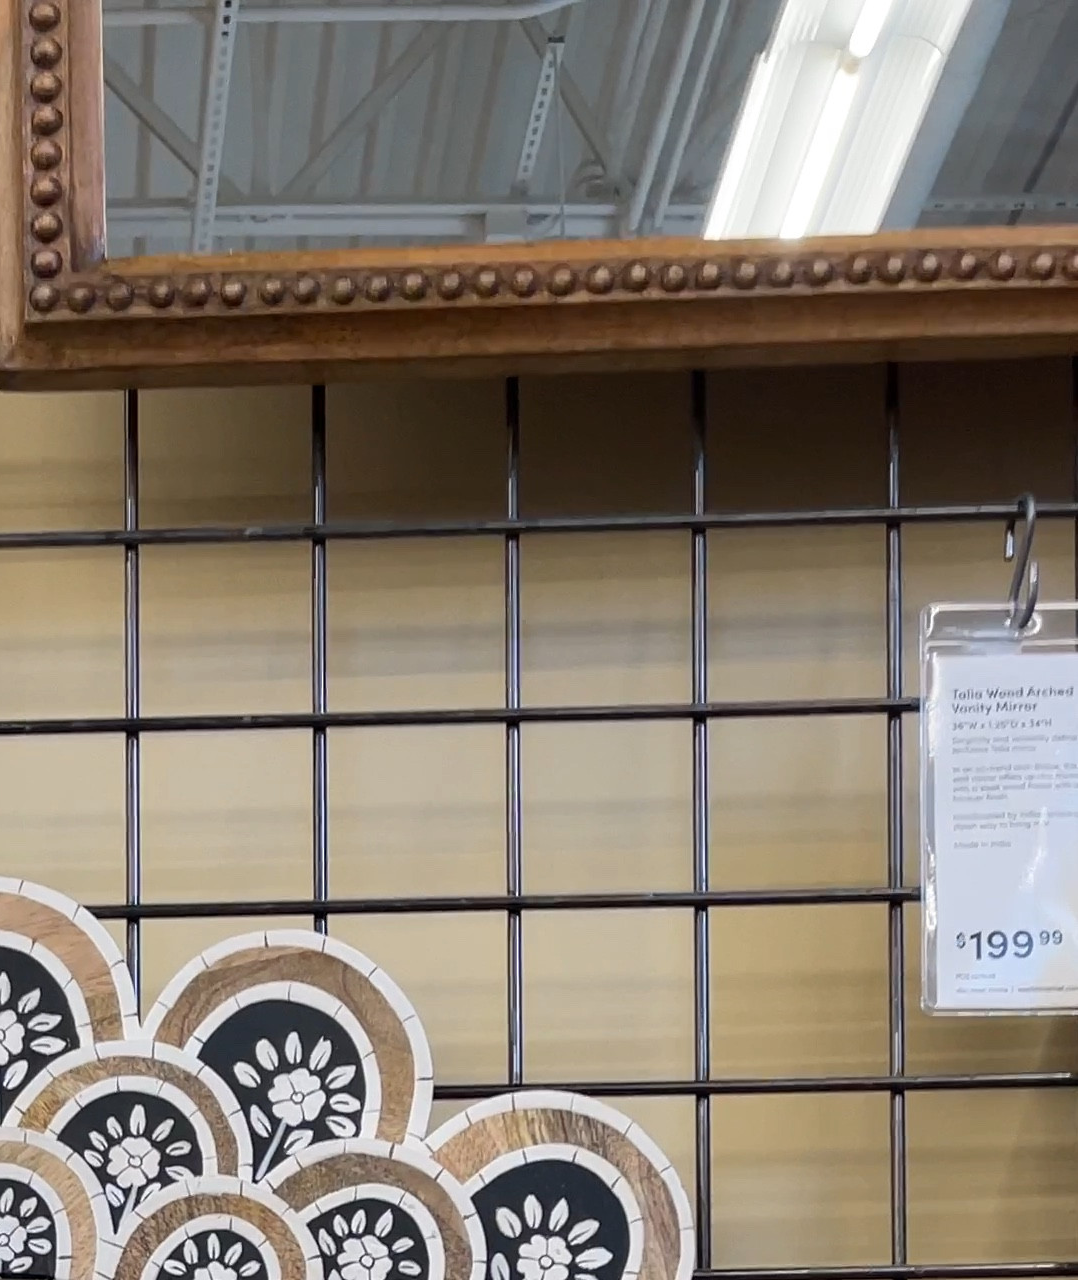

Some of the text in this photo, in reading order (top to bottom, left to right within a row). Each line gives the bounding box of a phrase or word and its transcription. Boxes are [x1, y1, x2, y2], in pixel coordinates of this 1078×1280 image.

[986, 687, 1024, 699] Wood
[1027, 686, 1074, 697] Arched
[952, 701, 1037, 715] Vanity Mirror
